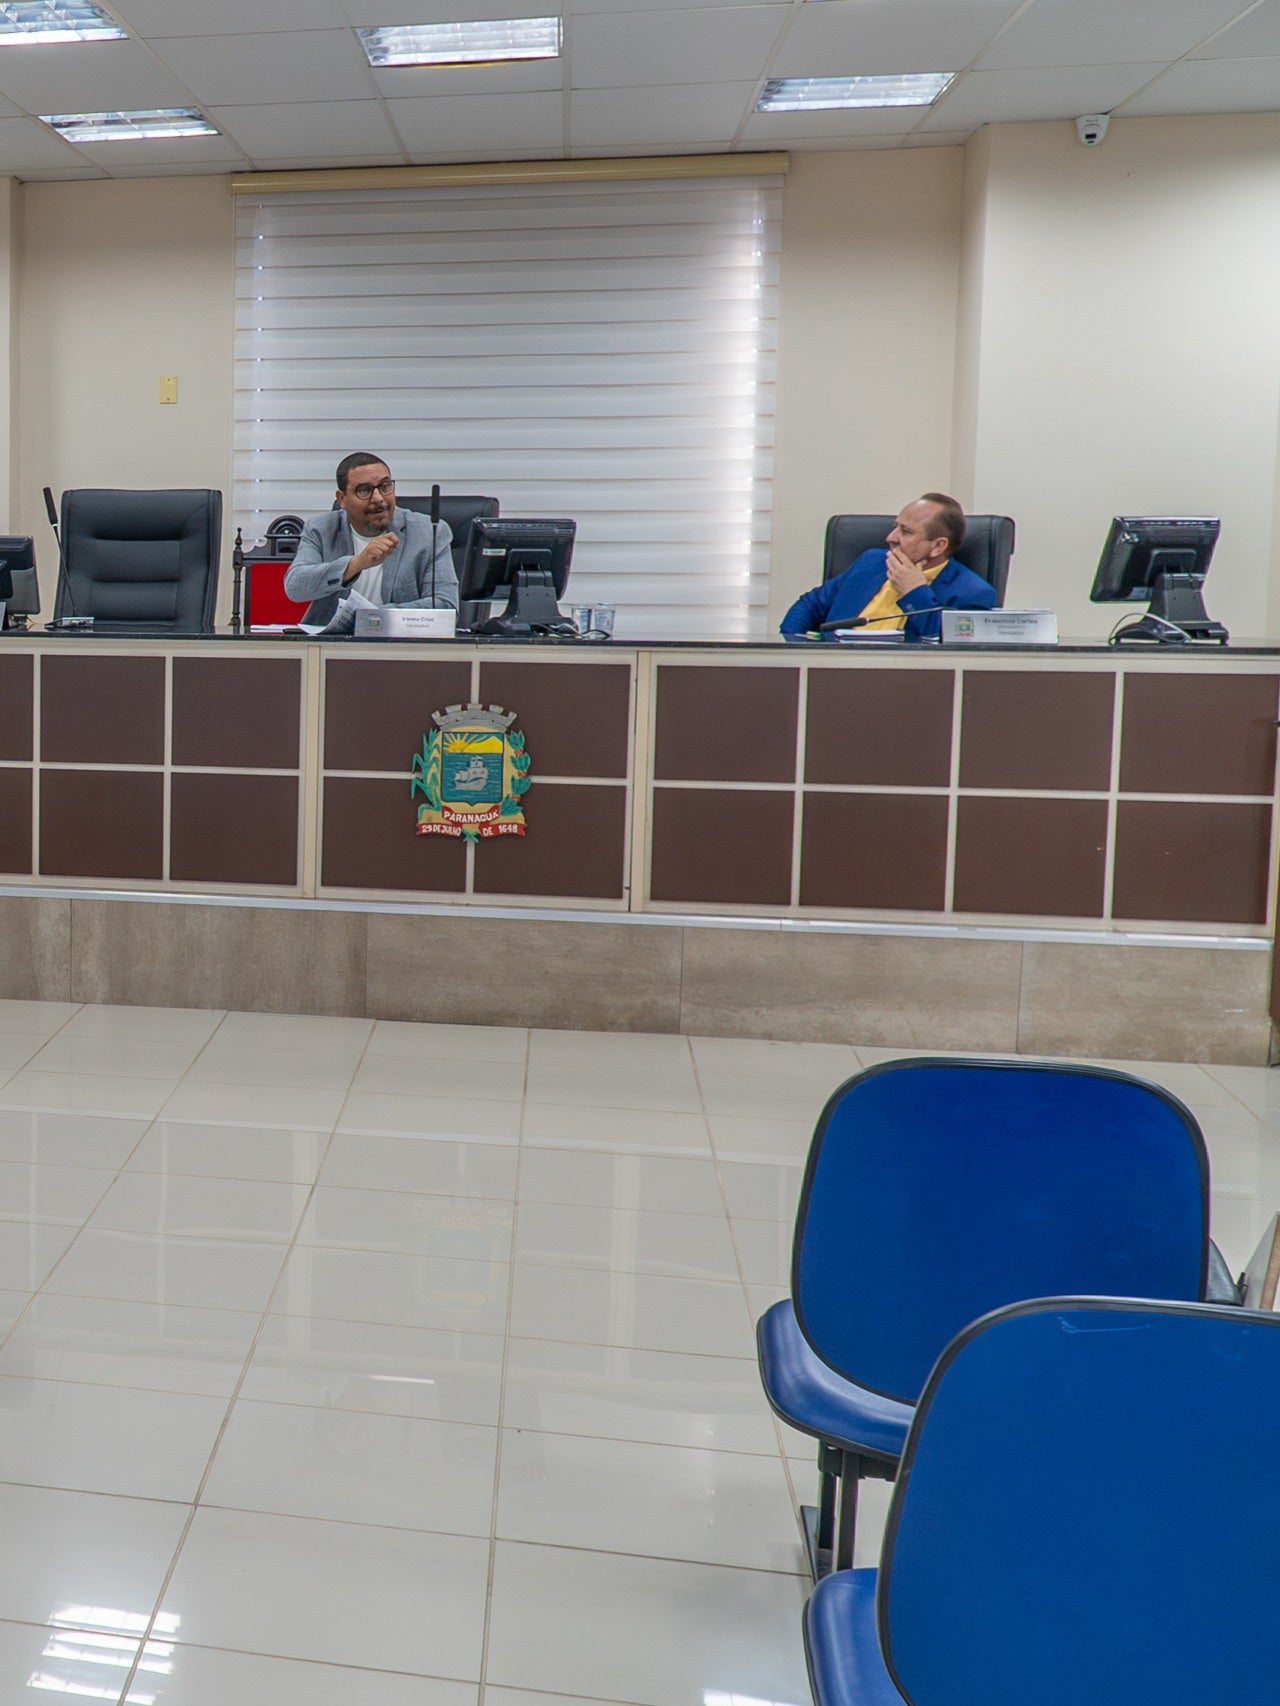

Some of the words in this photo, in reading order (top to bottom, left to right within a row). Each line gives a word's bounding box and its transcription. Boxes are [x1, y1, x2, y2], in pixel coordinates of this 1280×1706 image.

[443, 810, 499, 823] PARANAGUÁ
[422, 825, 432, 834] 29
[441, 825, 462, 836] JULHO
[483, 828, 494, 837] DE
[498, 825, 518, 834] 1648
